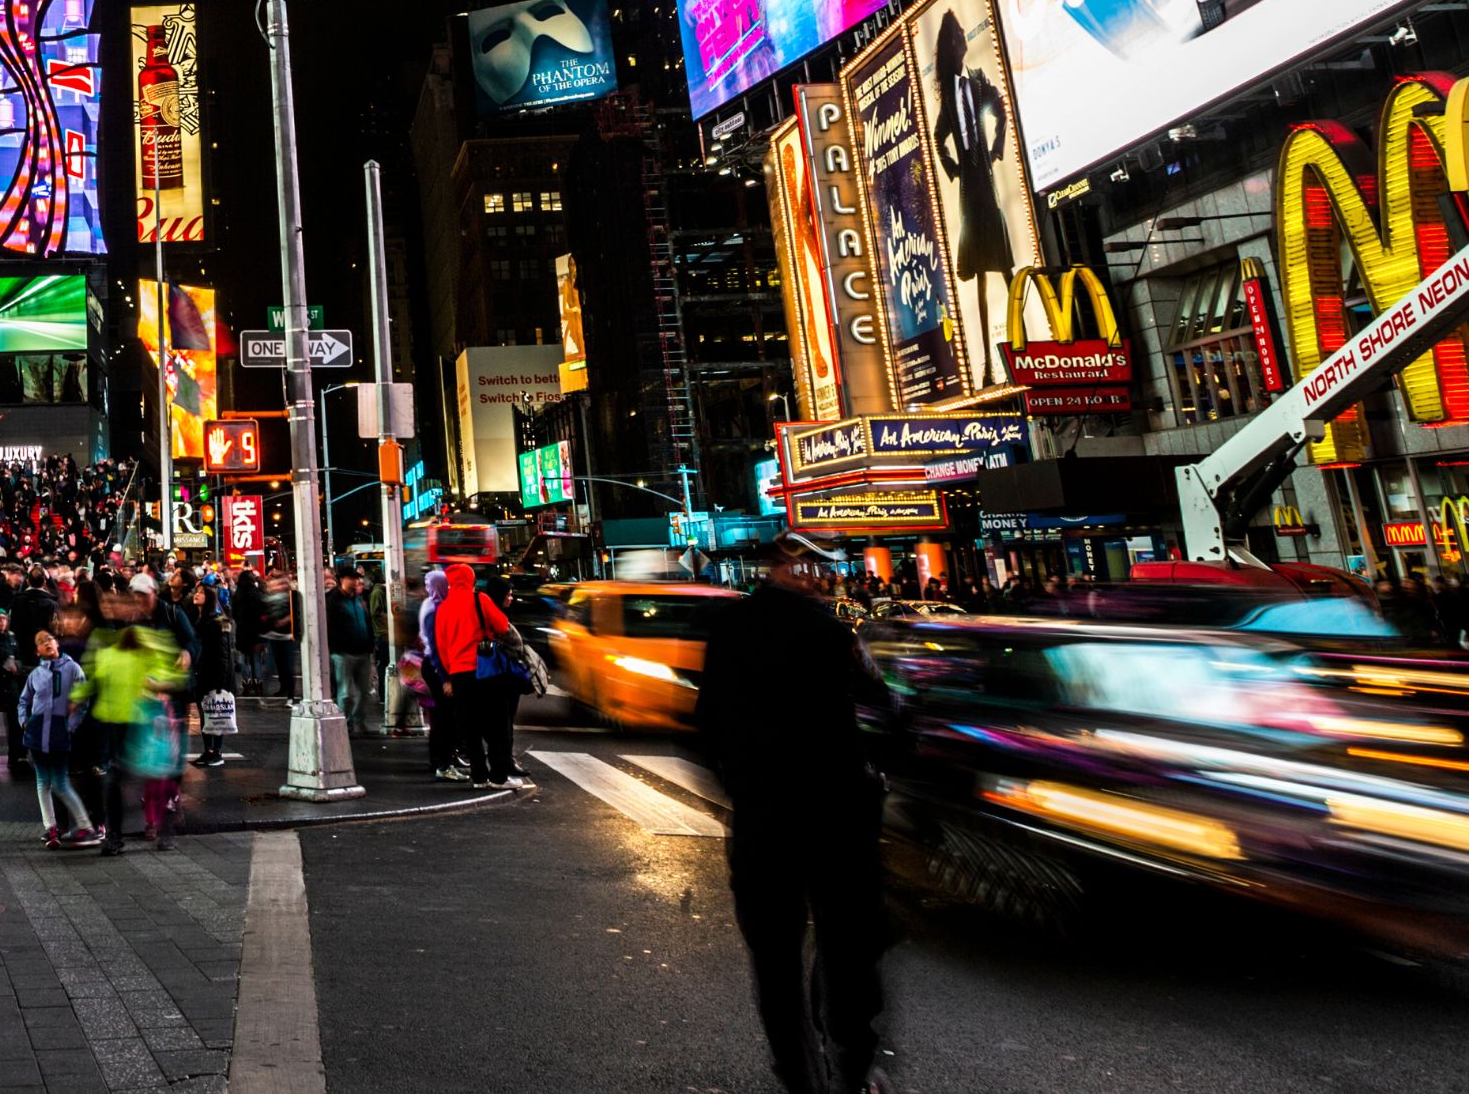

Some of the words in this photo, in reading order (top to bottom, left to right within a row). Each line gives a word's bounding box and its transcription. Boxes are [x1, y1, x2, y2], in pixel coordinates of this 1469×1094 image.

[533, 62, 610, 85] PHANTOM
[561, 58, 578, 68] THE
[539, 85, 551, 93] OF
[554, 81, 572, 90] THE
[573, 76, 605, 87] OPERA
[864, 86, 912, 158] Winner!
[886, 146, 899, 166] TONY
[899, 132, 920, 158] AWARDS
[819, 103, 878, 345] PALACE
[890, 204, 905, 245] An
[887, 232, 937, 286] American
[901, 265, 932, 309] Paris
[272, 310, 285, 328] W
[310, 310, 319, 319] ST
[1248, 286, 1261, 323] OPEN
[1259, 337, 1275, 385] HOURS
[1304, 350, 1357, 406] NORTH
[1359, 302, 1416, 362] SHORE
[1418, 258, 1469, 314] NEON
[251, 342, 283, 356] ONE
[307, 342, 336, 356] WAY
[1015, 353, 1127, 369] McDonald's
[478, 375, 518, 386] Switch
[521, 375, 532, 385] to
[1034, 369, 1109, 380] Restaurant
[479, 393, 519, 403] Switch
[1029, 397, 1063, 406] OPEN
[1066, 396, 1081, 405] 24
[880, 426, 898, 447] An
[900, 423, 963, 448] American
[964, 422, 1001, 446] Paris
[925, 461, 955, 480] CHANGE
[956, 456, 984, 475] MONEY
[988, 452, 1008, 469] ATM
[829, 506, 866, 518] American
[867, 505, 887, 517] Paris
[232, 500, 256, 549] tkts
[982, 518, 1027, 529] MONEY
